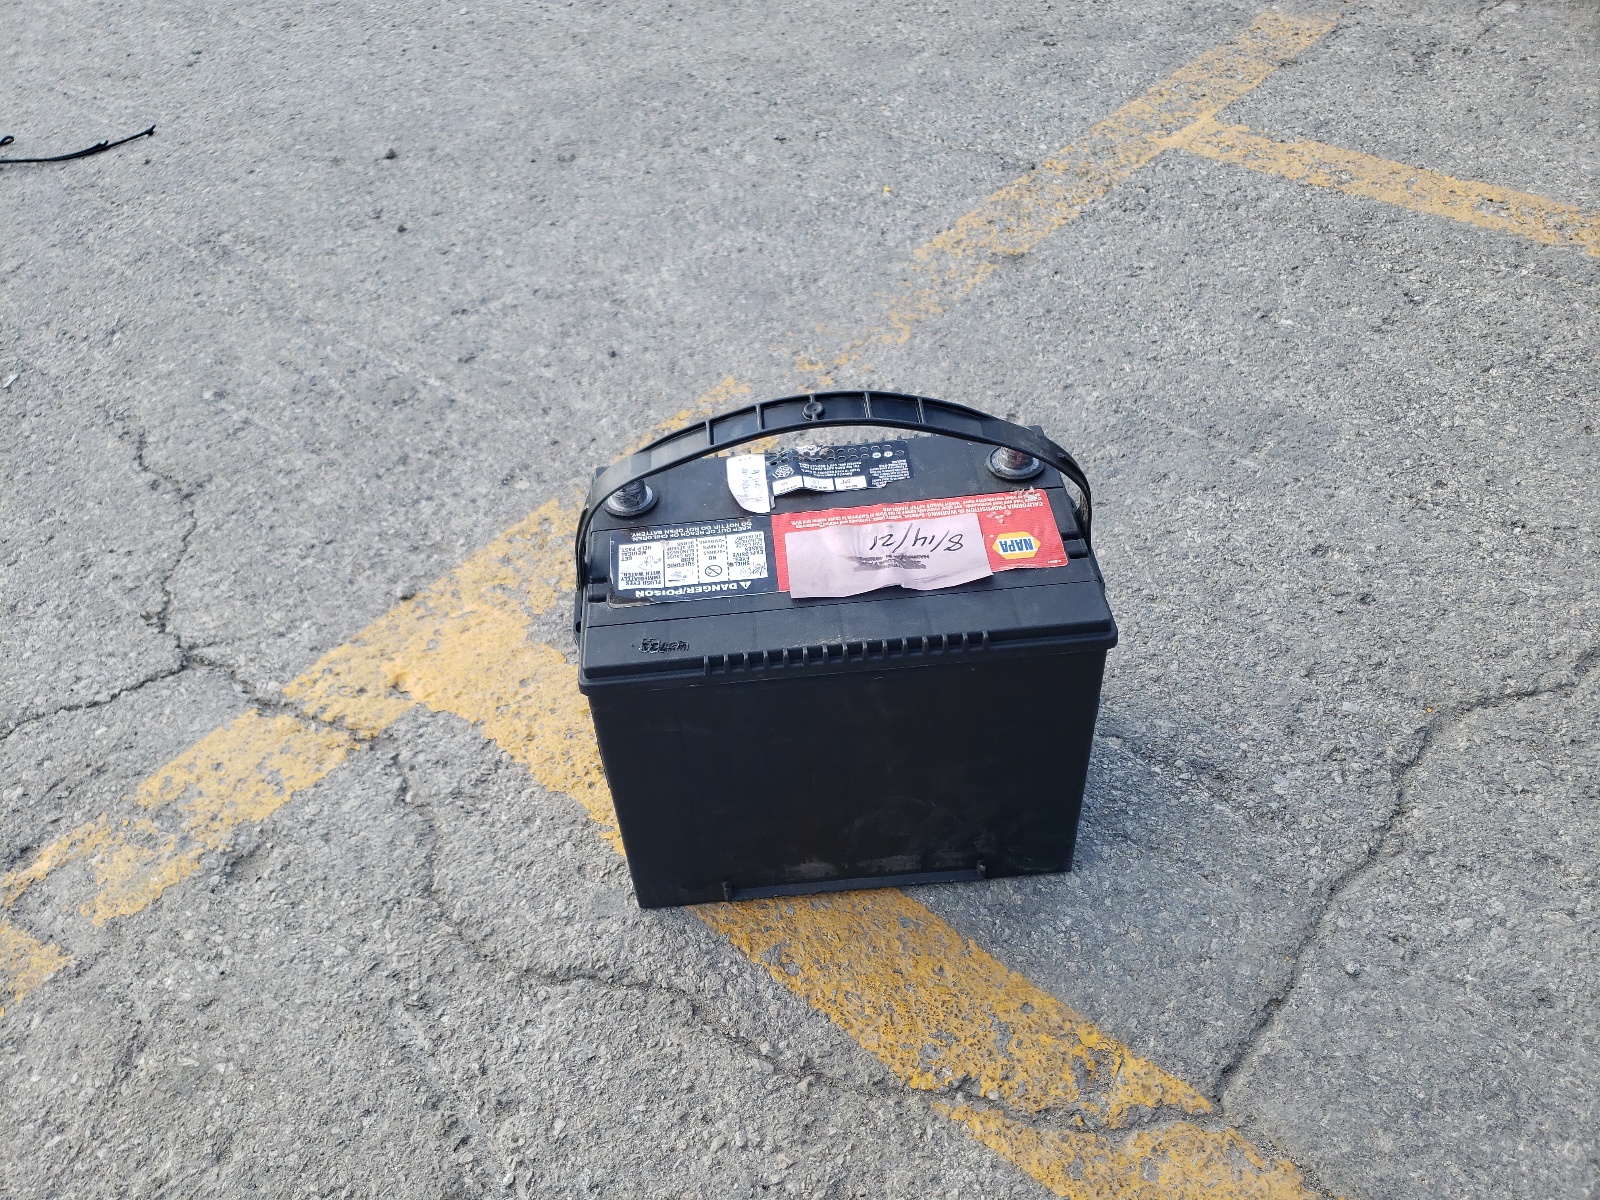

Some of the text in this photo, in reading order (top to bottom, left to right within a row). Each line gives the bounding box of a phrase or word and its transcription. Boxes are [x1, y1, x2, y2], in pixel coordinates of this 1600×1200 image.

[966, 505, 1006, 514] PROPOSITION
[1007, 502, 1043, 510] CALIFORNIA
[869, 523, 964, 552] 8/14/21
[998, 538, 1034, 552] NAPA
[635, 582, 737, 597] DANGER/POISON
